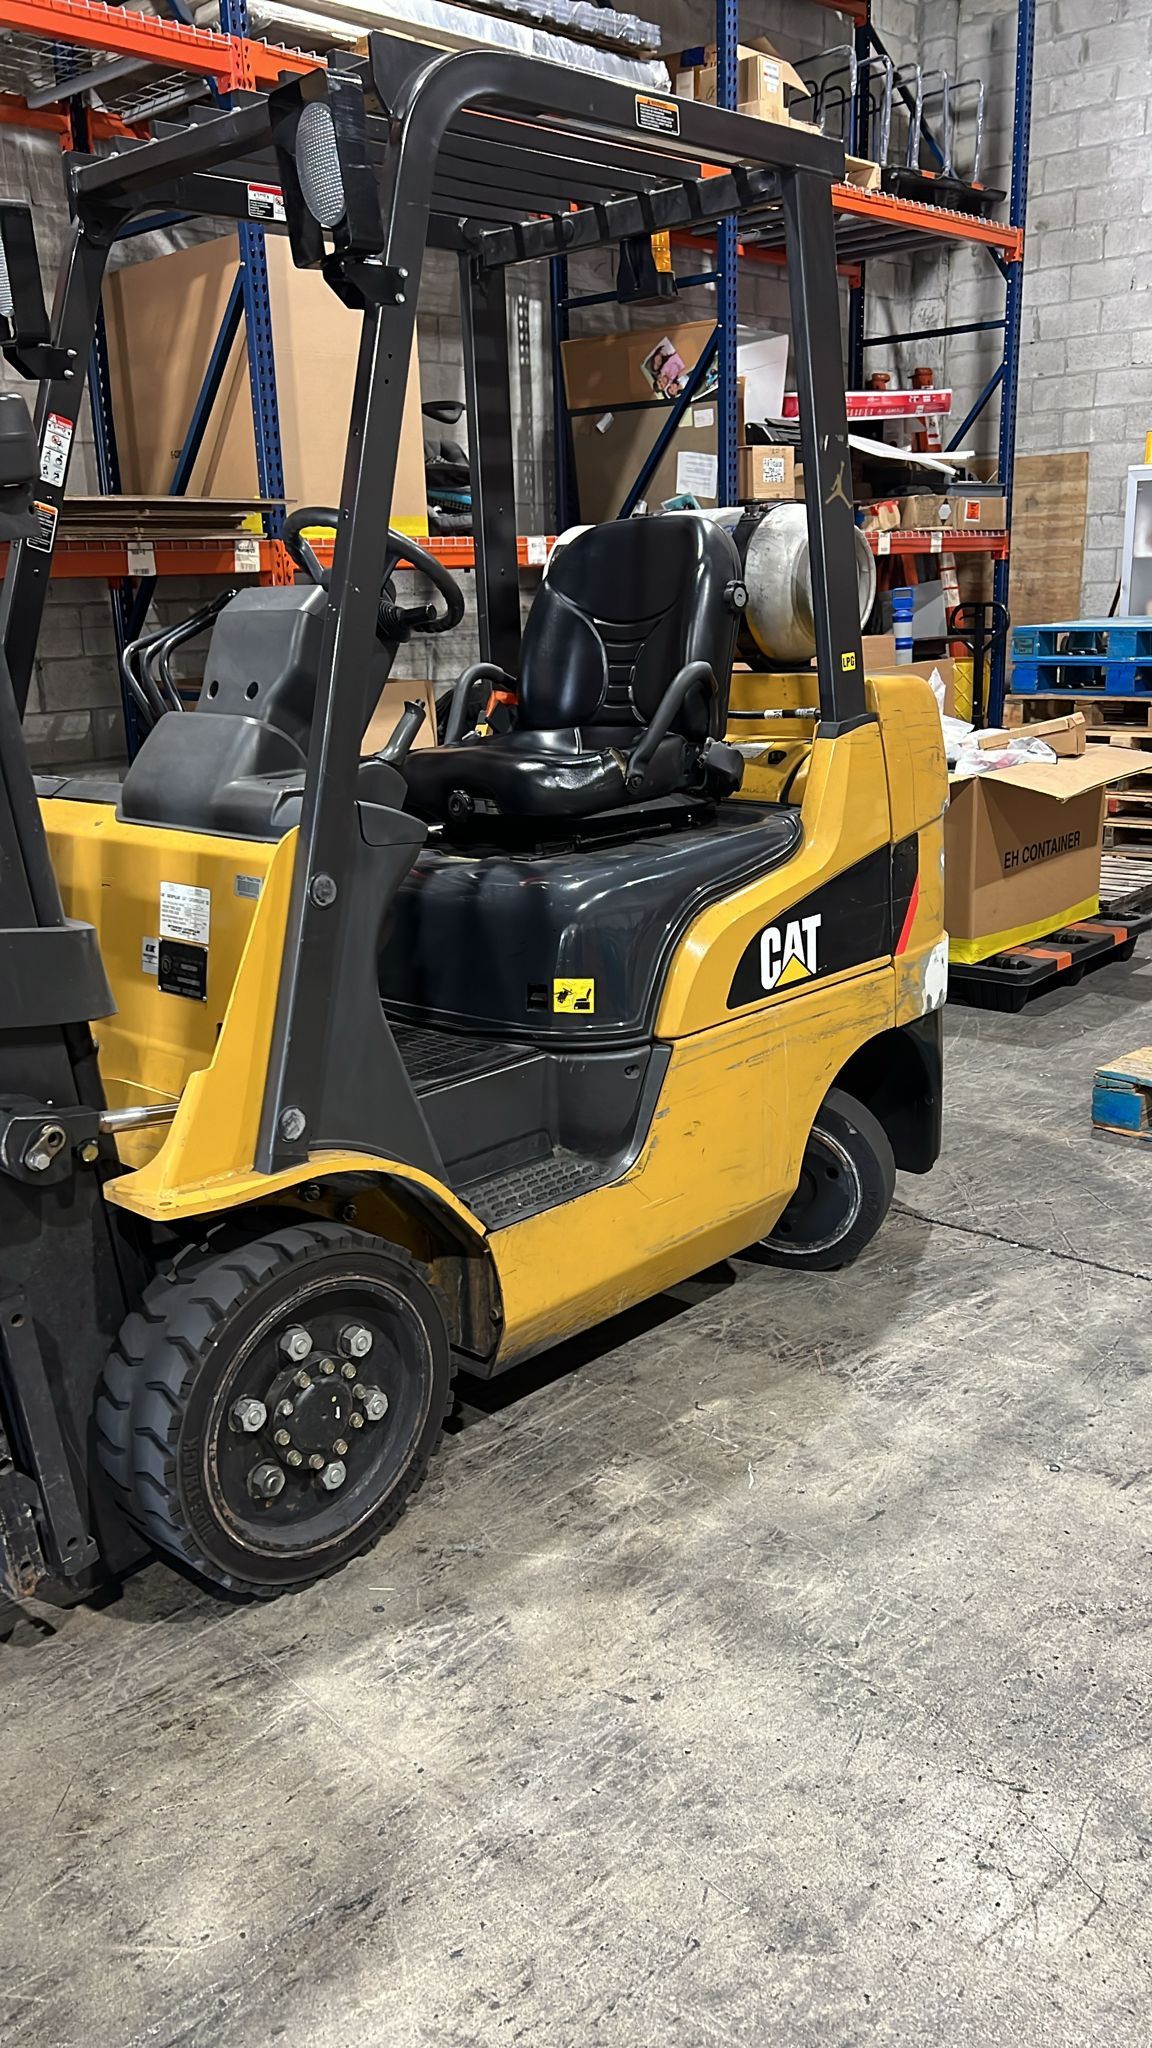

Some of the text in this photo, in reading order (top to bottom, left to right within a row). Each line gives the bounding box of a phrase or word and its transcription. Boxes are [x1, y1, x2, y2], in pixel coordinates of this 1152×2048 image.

[842, 655, 855, 668] LPG
[1003, 830, 1081, 869] EH CONTAINER
[760, 913, 822, 990] CAT
